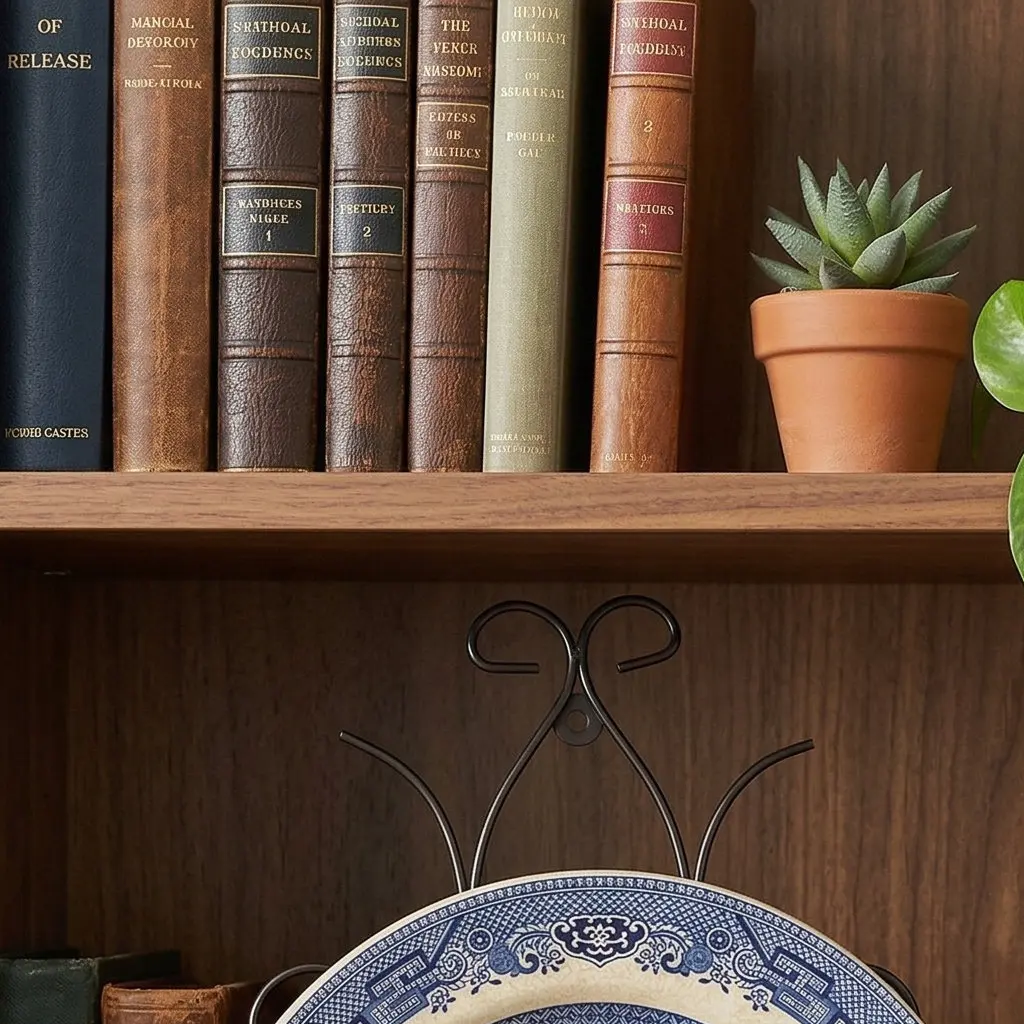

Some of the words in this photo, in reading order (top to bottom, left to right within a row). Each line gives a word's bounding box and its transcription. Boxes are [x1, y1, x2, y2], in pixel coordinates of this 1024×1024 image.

[37, 18, 63, 34] OF
[441, 19, 470, 32] THE
[7, 53, 92, 69] RELEASE
[265, 229, 272, 242] 1
[362, 225, 372, 238] 2
[44, 427, 89, 439] CASTES
